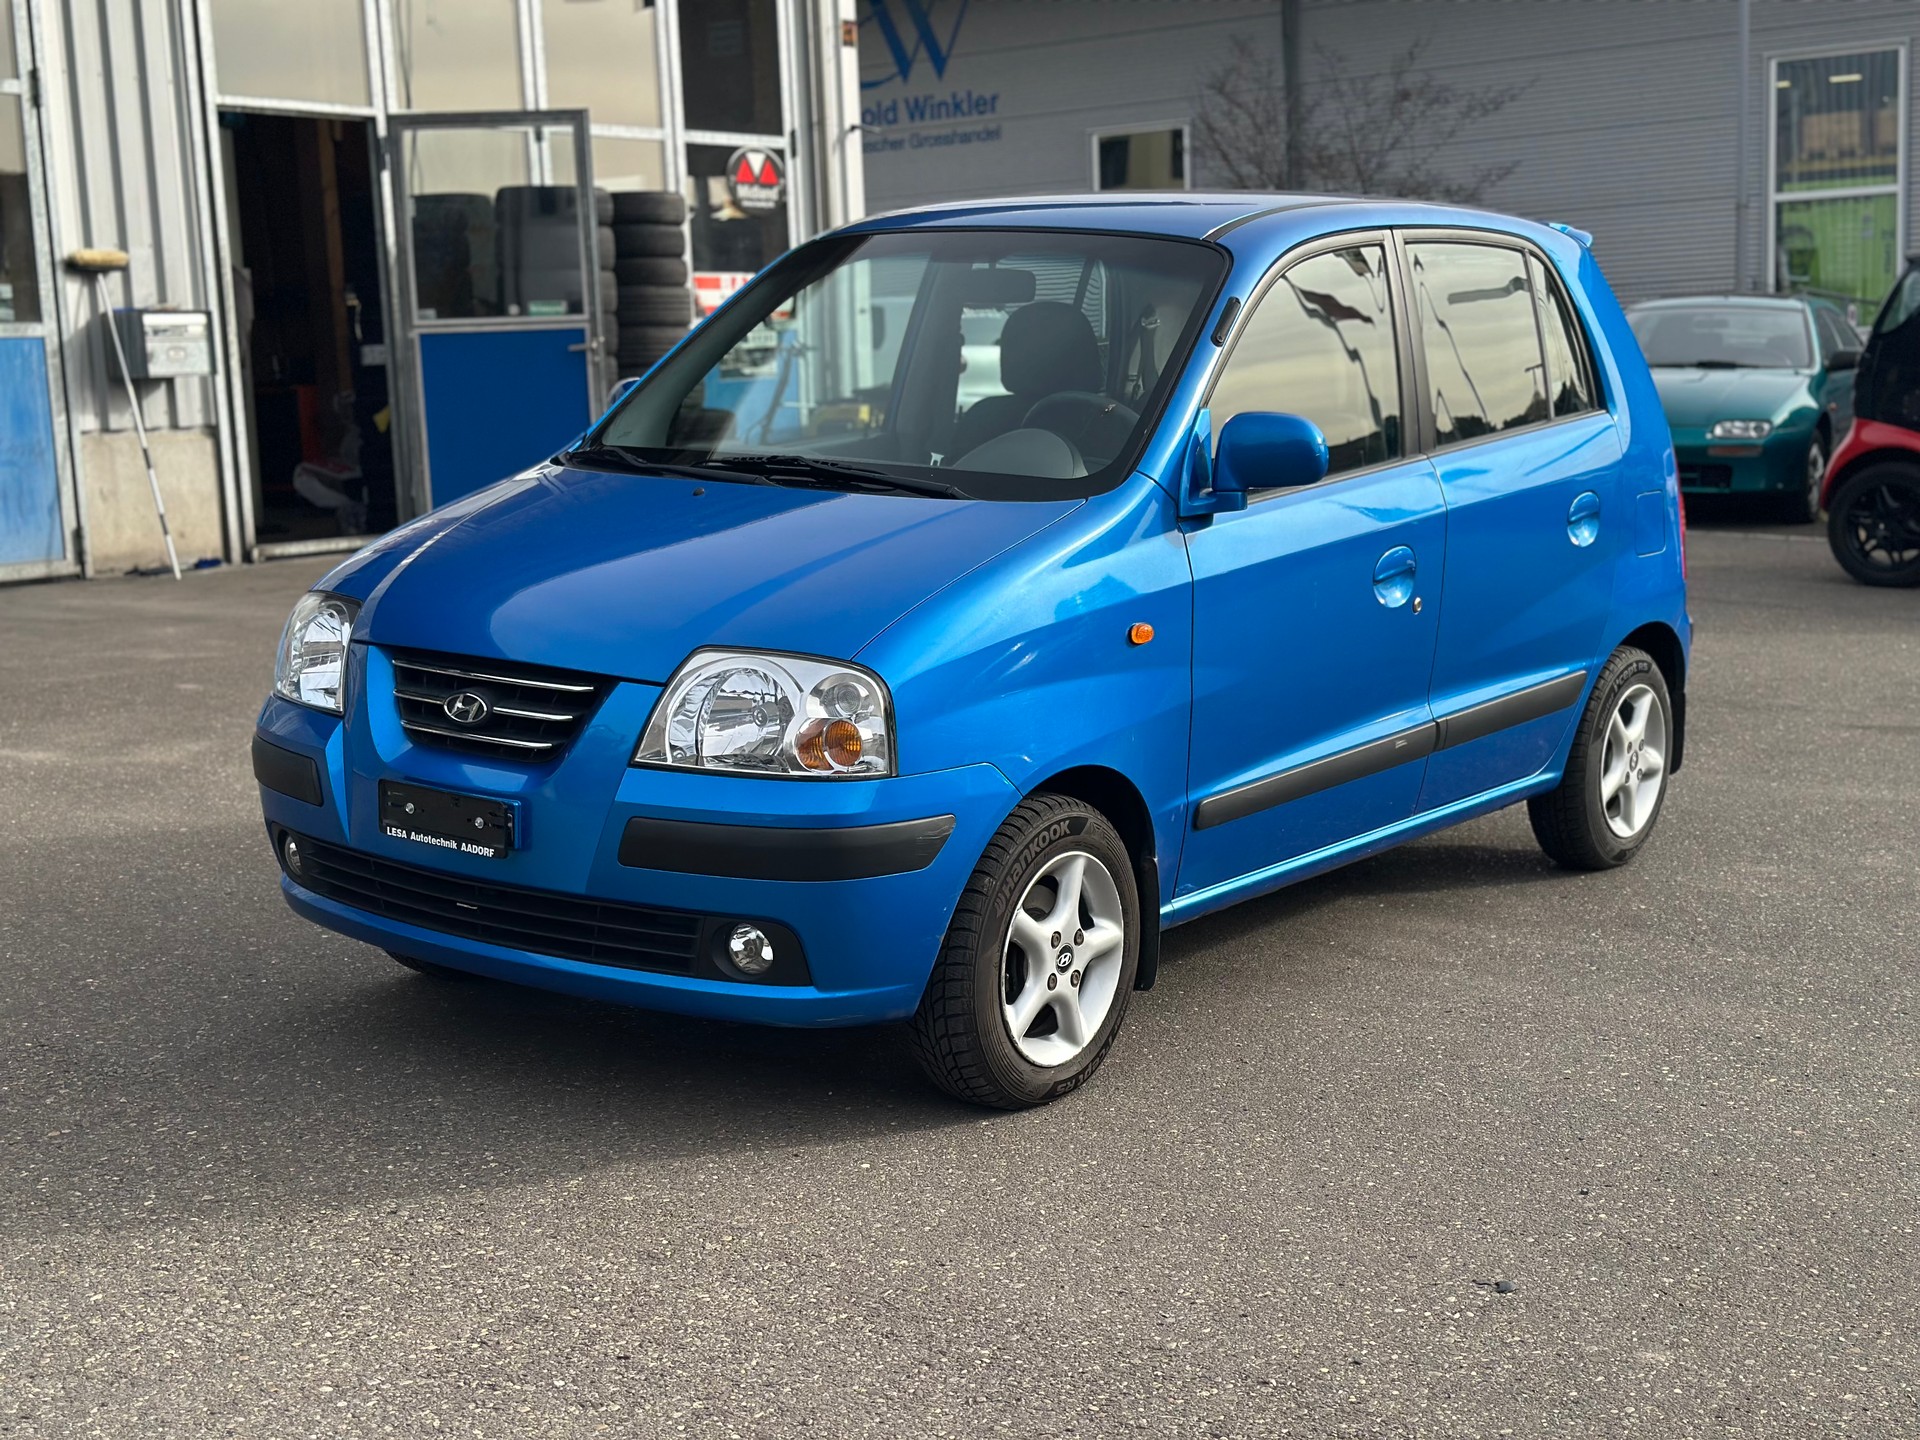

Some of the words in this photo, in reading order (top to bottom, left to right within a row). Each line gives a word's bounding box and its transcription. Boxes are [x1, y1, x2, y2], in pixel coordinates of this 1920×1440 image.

[861, 98, 898, 126] old
[904, 90, 999, 122] Winkler
[863, 136, 905, 154] scher
[386, 826, 408, 839] LESA
[410, 831, 458, 850] Autotechnik
[461, 842, 495, 858] AADORF
